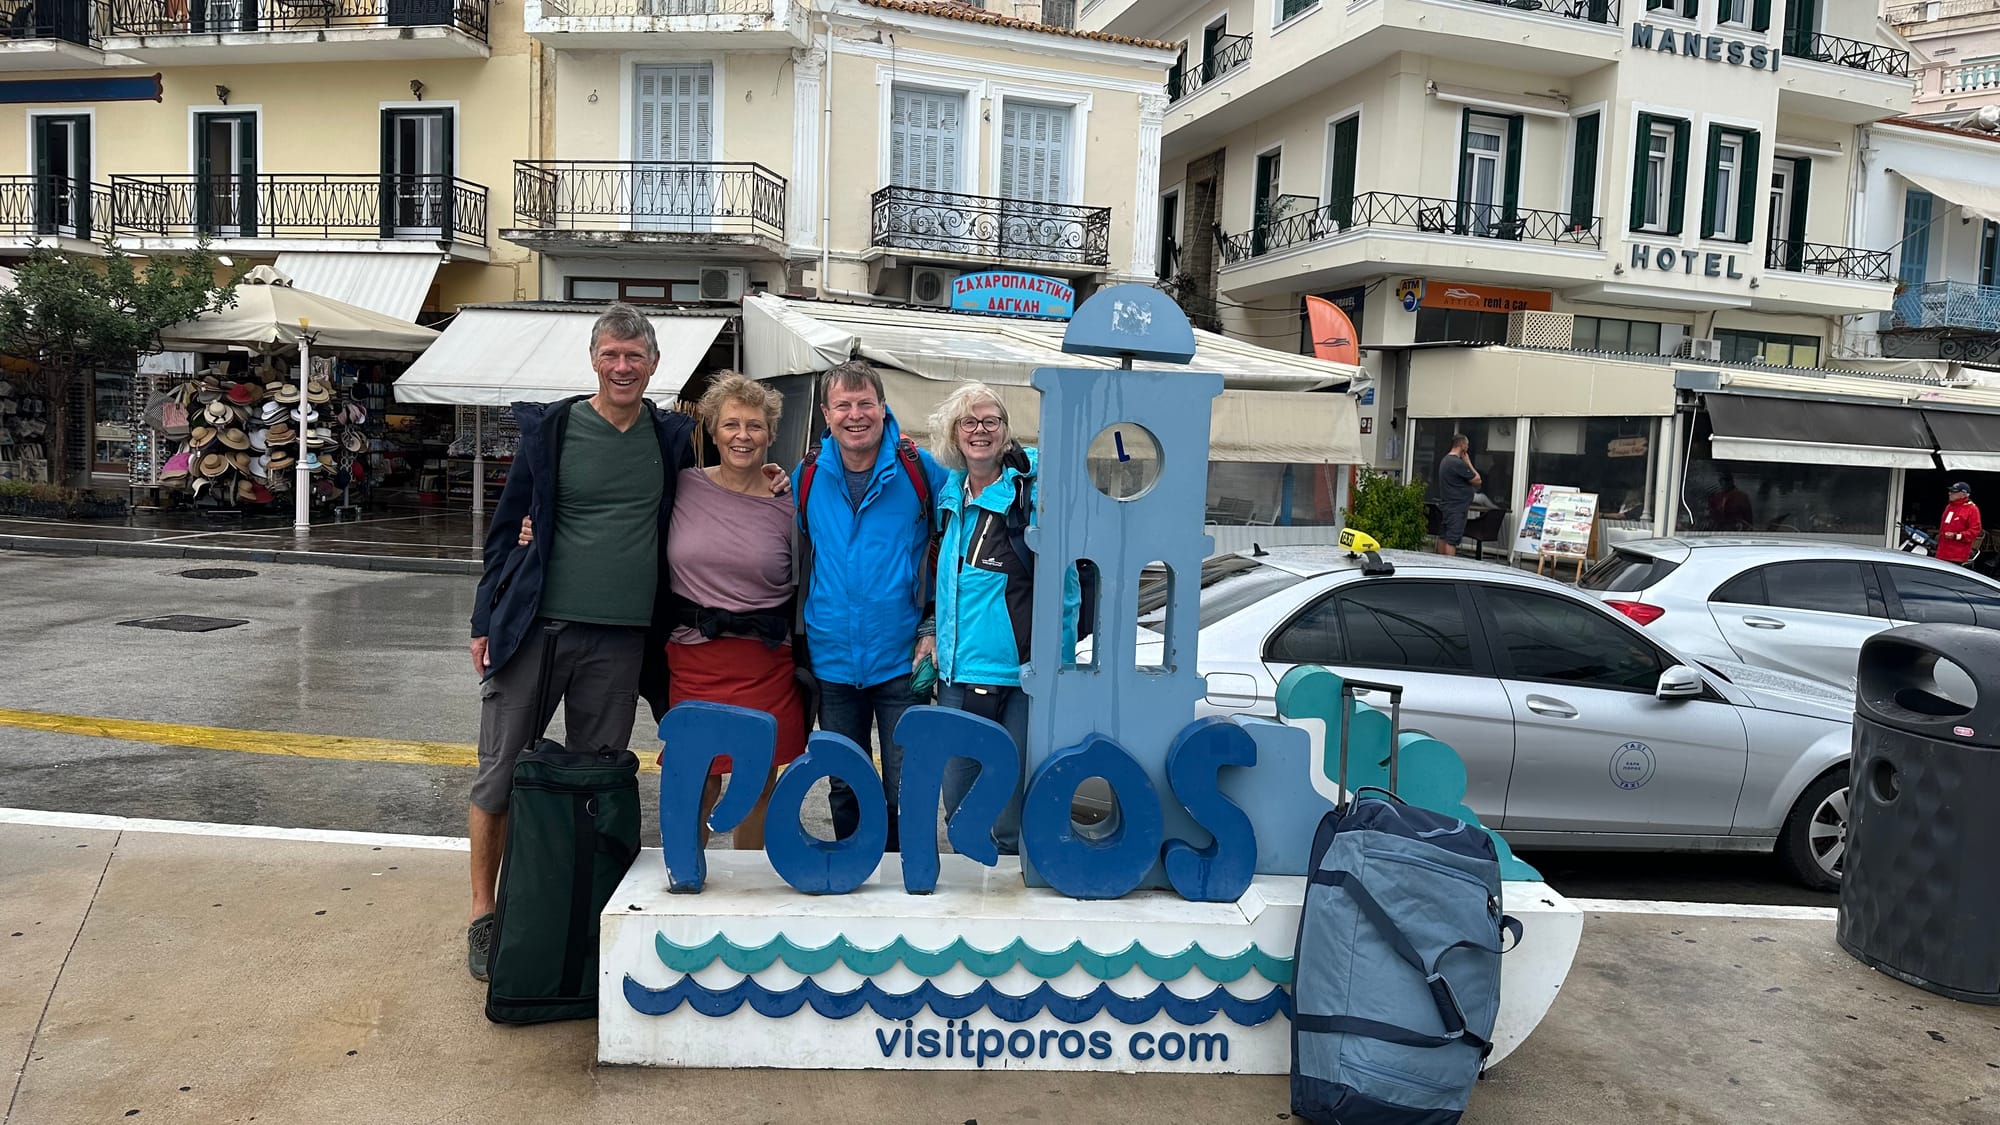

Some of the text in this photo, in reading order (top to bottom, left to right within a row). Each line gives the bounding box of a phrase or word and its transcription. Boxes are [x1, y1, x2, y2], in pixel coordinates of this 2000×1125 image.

[1632, 22, 1779, 72] MANESSI
[1631, 243, 1743, 280] HOTEL
[955, 275, 1073, 302] ΖΑΧΑΡΟΠΛΑΣΤΙΚΗ
[1401, 280, 1420, 290] ATM
[988, 297, 1040, 313] ΔΑΓΚΛΗ
[1483, 297, 1502, 309] rent
[1503, 299, 1510, 310] a
[1512, 300, 1528, 311] car
[1341, 532, 1354, 546] TAXI
[657, 700, 1257, 902] POROS
[875, 1020, 1229, 1068] visitporos com
